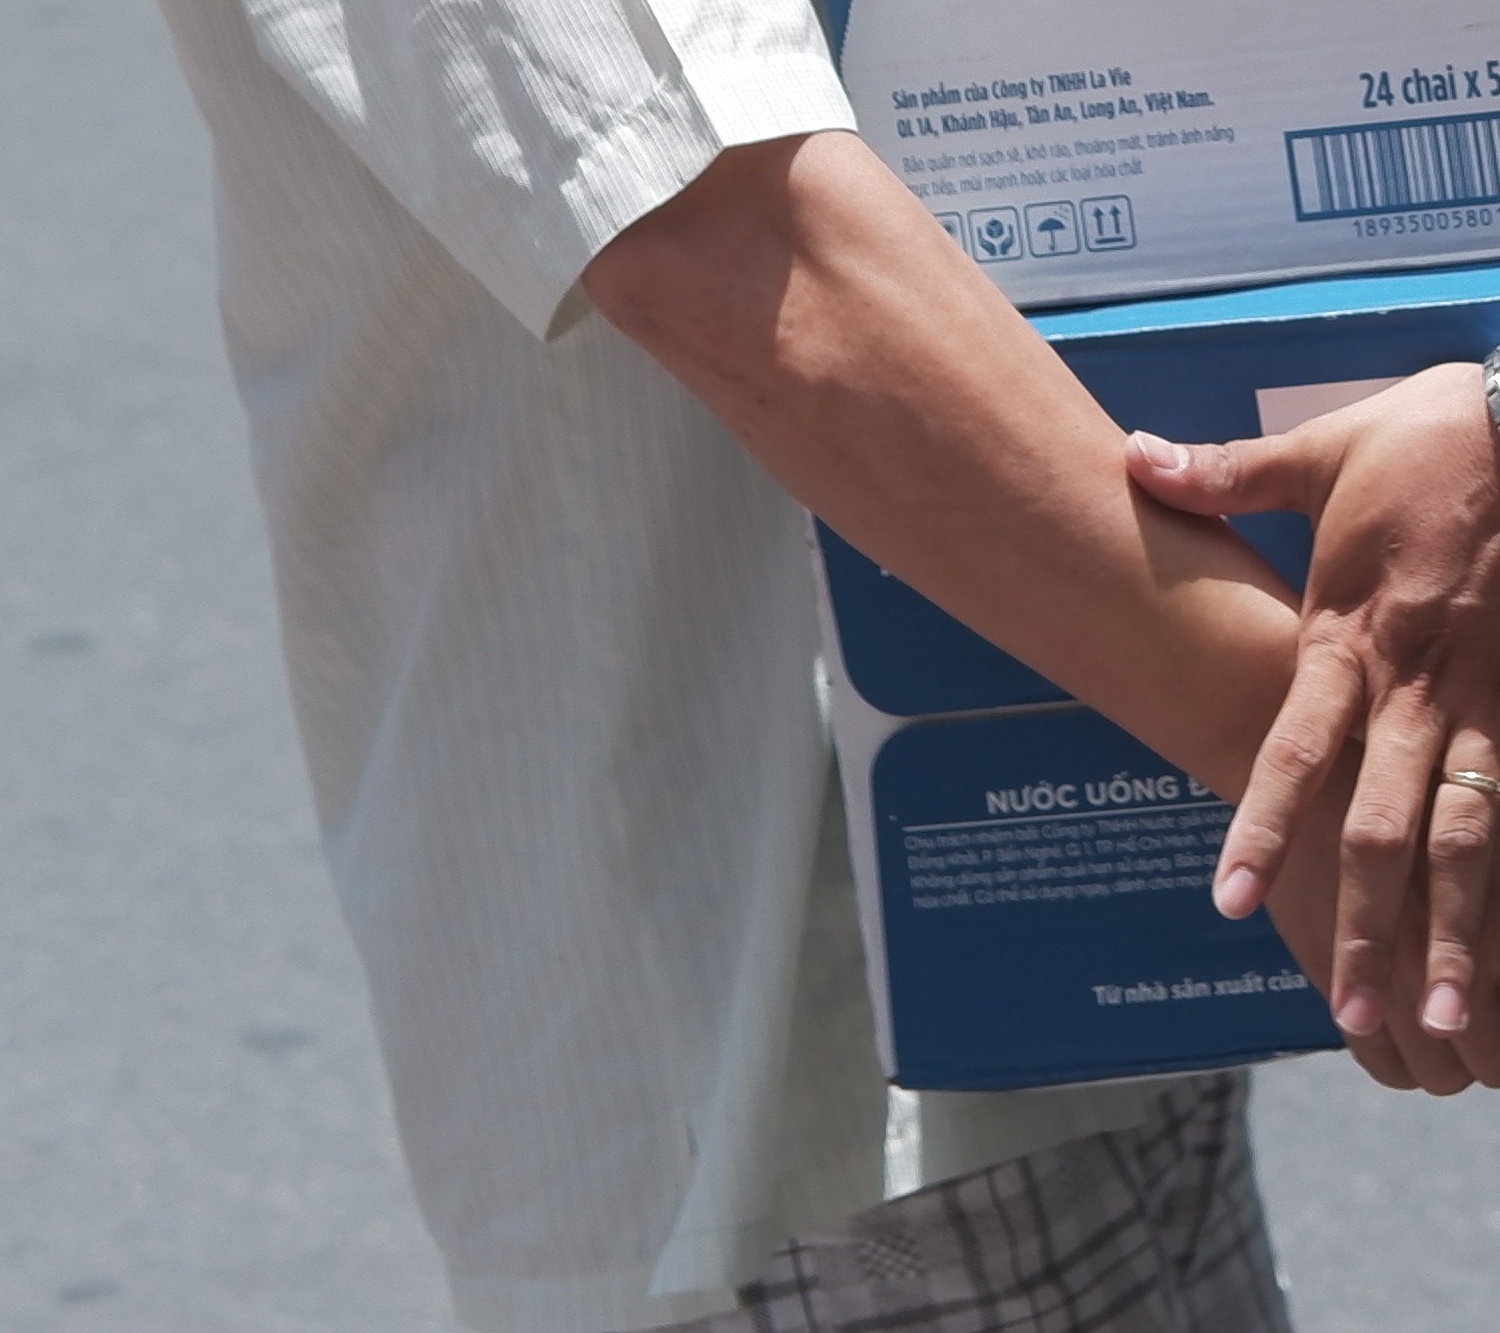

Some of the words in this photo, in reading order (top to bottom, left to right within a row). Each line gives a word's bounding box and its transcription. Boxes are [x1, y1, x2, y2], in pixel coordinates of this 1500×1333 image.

[892, 89, 918, 110] Sản
[920, 81, 962, 109] phẩm
[964, 82, 989, 102] của
[992, 79, 1028, 100] Công
[1029, 77, 1045, 98] ty
[1047, 70, 1087, 93] TNHH
[1089, 69, 1106, 89] La
[1107, 66, 1132, 88] Vie
[1359, 71, 1396, 109] 24
[1402, 64, 1457, 105] chai
[1464, 69, 1483, 99] x
[897, 117, 915, 139] QL
[941, 111, 987, 133] Khánh
[989, 109, 1024, 132] Hậu,
[1024, 104, 1050, 125] Tân
[1053, 103, 1079, 123] An,
[1079, 100, 1116, 120] Long
[1119, 96, 1143, 117] An,
[1143, 91, 1174, 115] Việt
[1175, 88, 1215, 109] Nam.
[985, 779, 1078, 815] NƯỚC
[1084, 770, 1181, 807] UỐNG
[1091, 984, 1124, 1006] Từ
[1124, 980, 1169, 1004] nhà
[1170, 976, 1211, 1001] sản
[1213, 969, 1266, 997] xuất
[1267, 967, 1309, 993] của
